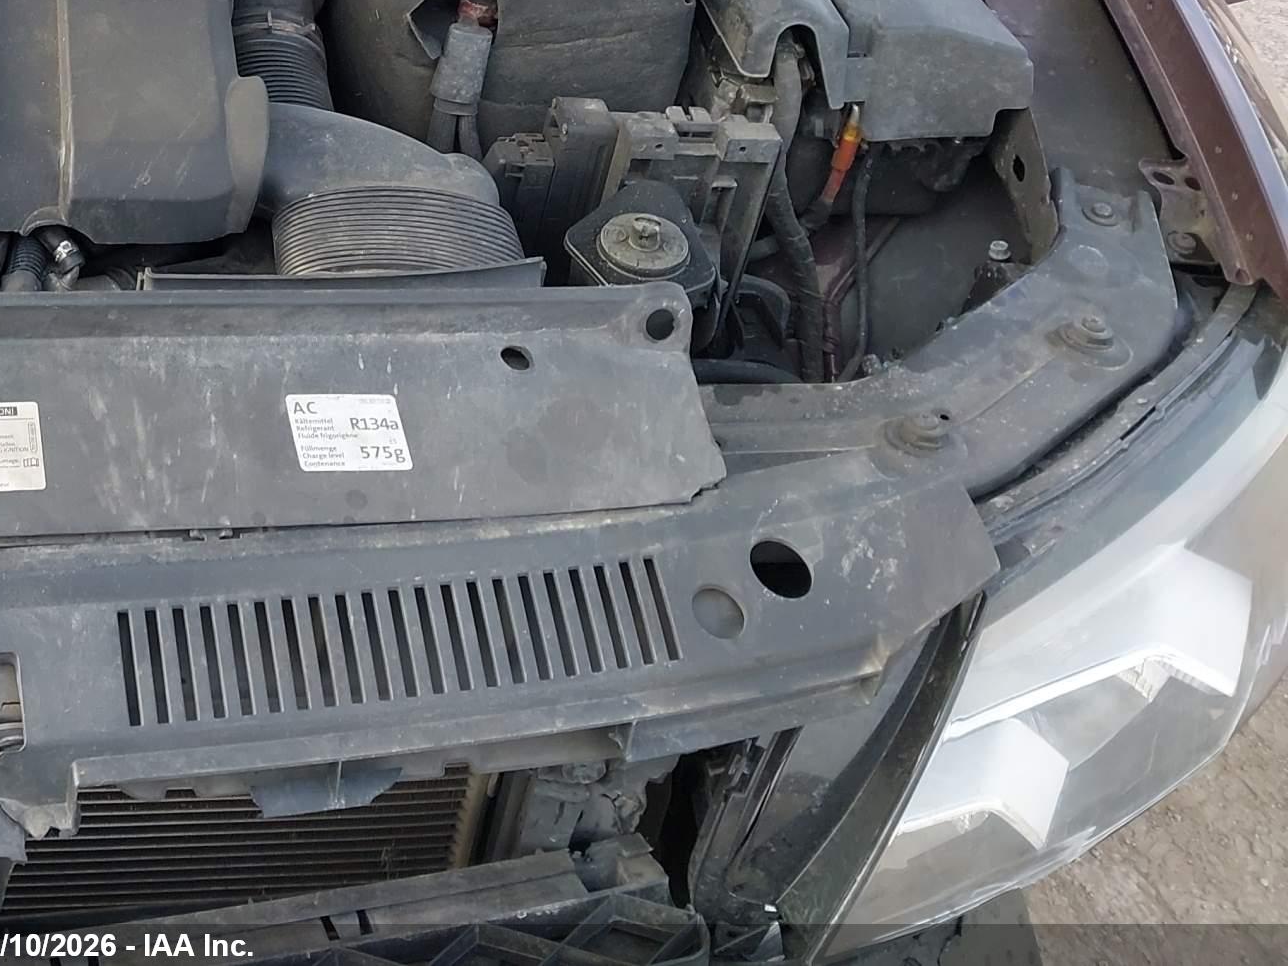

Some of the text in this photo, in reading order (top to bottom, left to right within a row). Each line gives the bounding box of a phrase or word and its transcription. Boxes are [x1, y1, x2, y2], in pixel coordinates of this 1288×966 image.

[293, 401, 318, 414] AC
[350, 417, 399, 430] R134a
[360, 446, 406, 463] 575g
